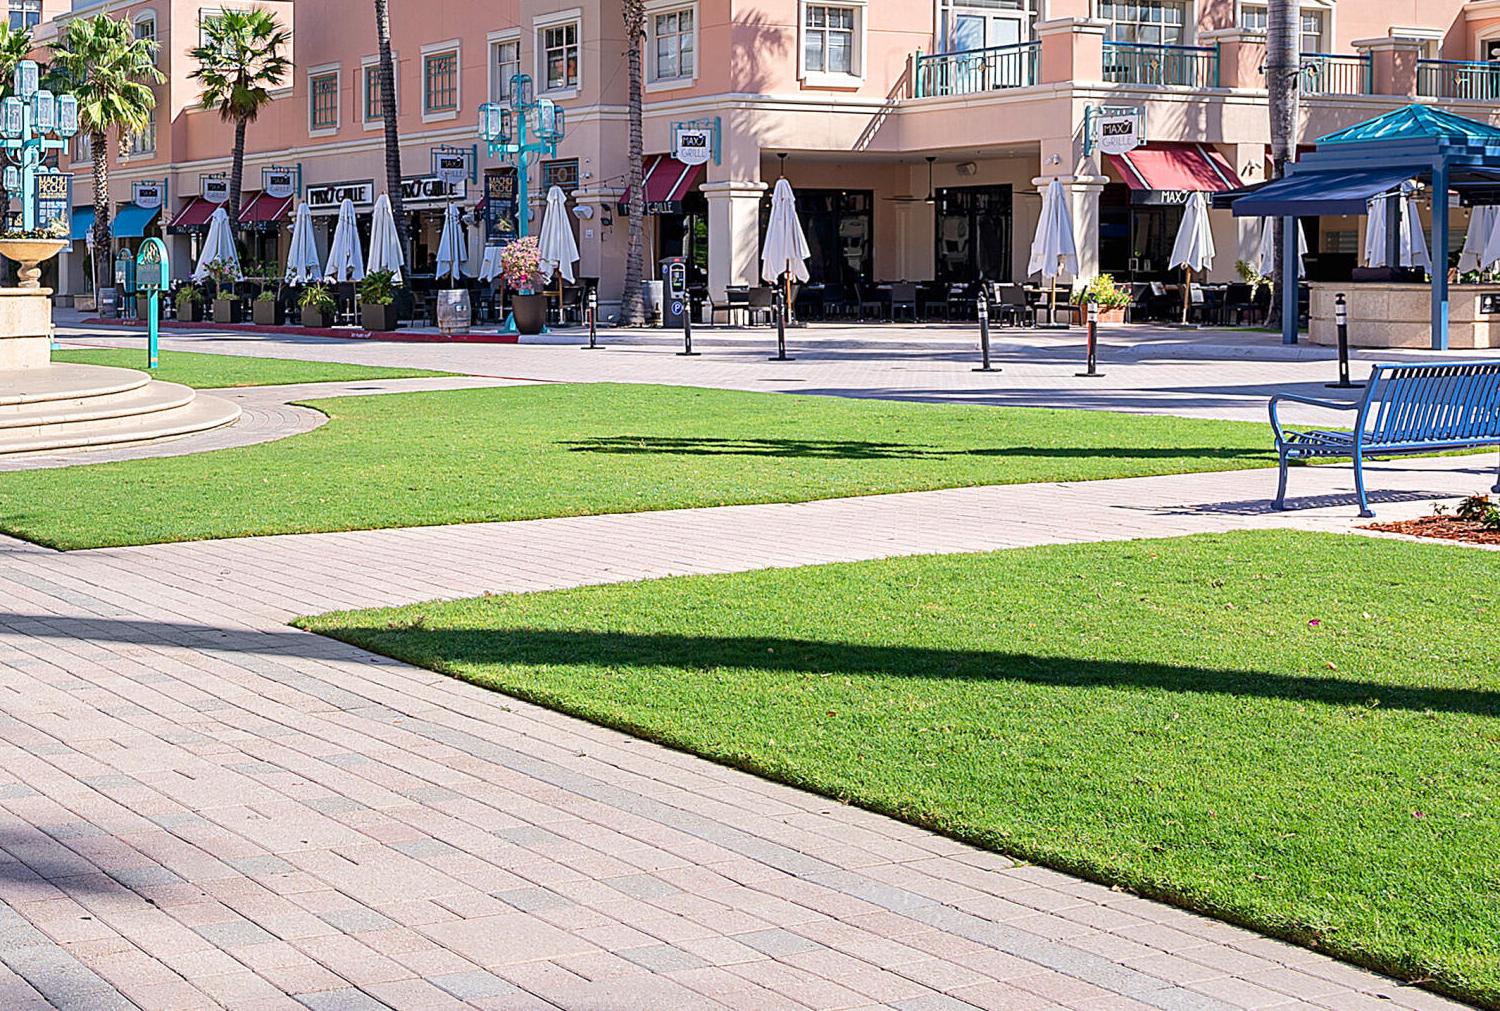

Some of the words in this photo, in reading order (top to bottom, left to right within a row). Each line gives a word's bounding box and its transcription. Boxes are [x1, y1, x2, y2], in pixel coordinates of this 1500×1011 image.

[1102, 135, 1132, 147] GRILLE
[681, 148, 706, 158] GRILLE
[39, 176, 68, 185] MACHU
[39, 183, 68, 193] PICCHU
[336, 187, 366, 203] GRILLE
